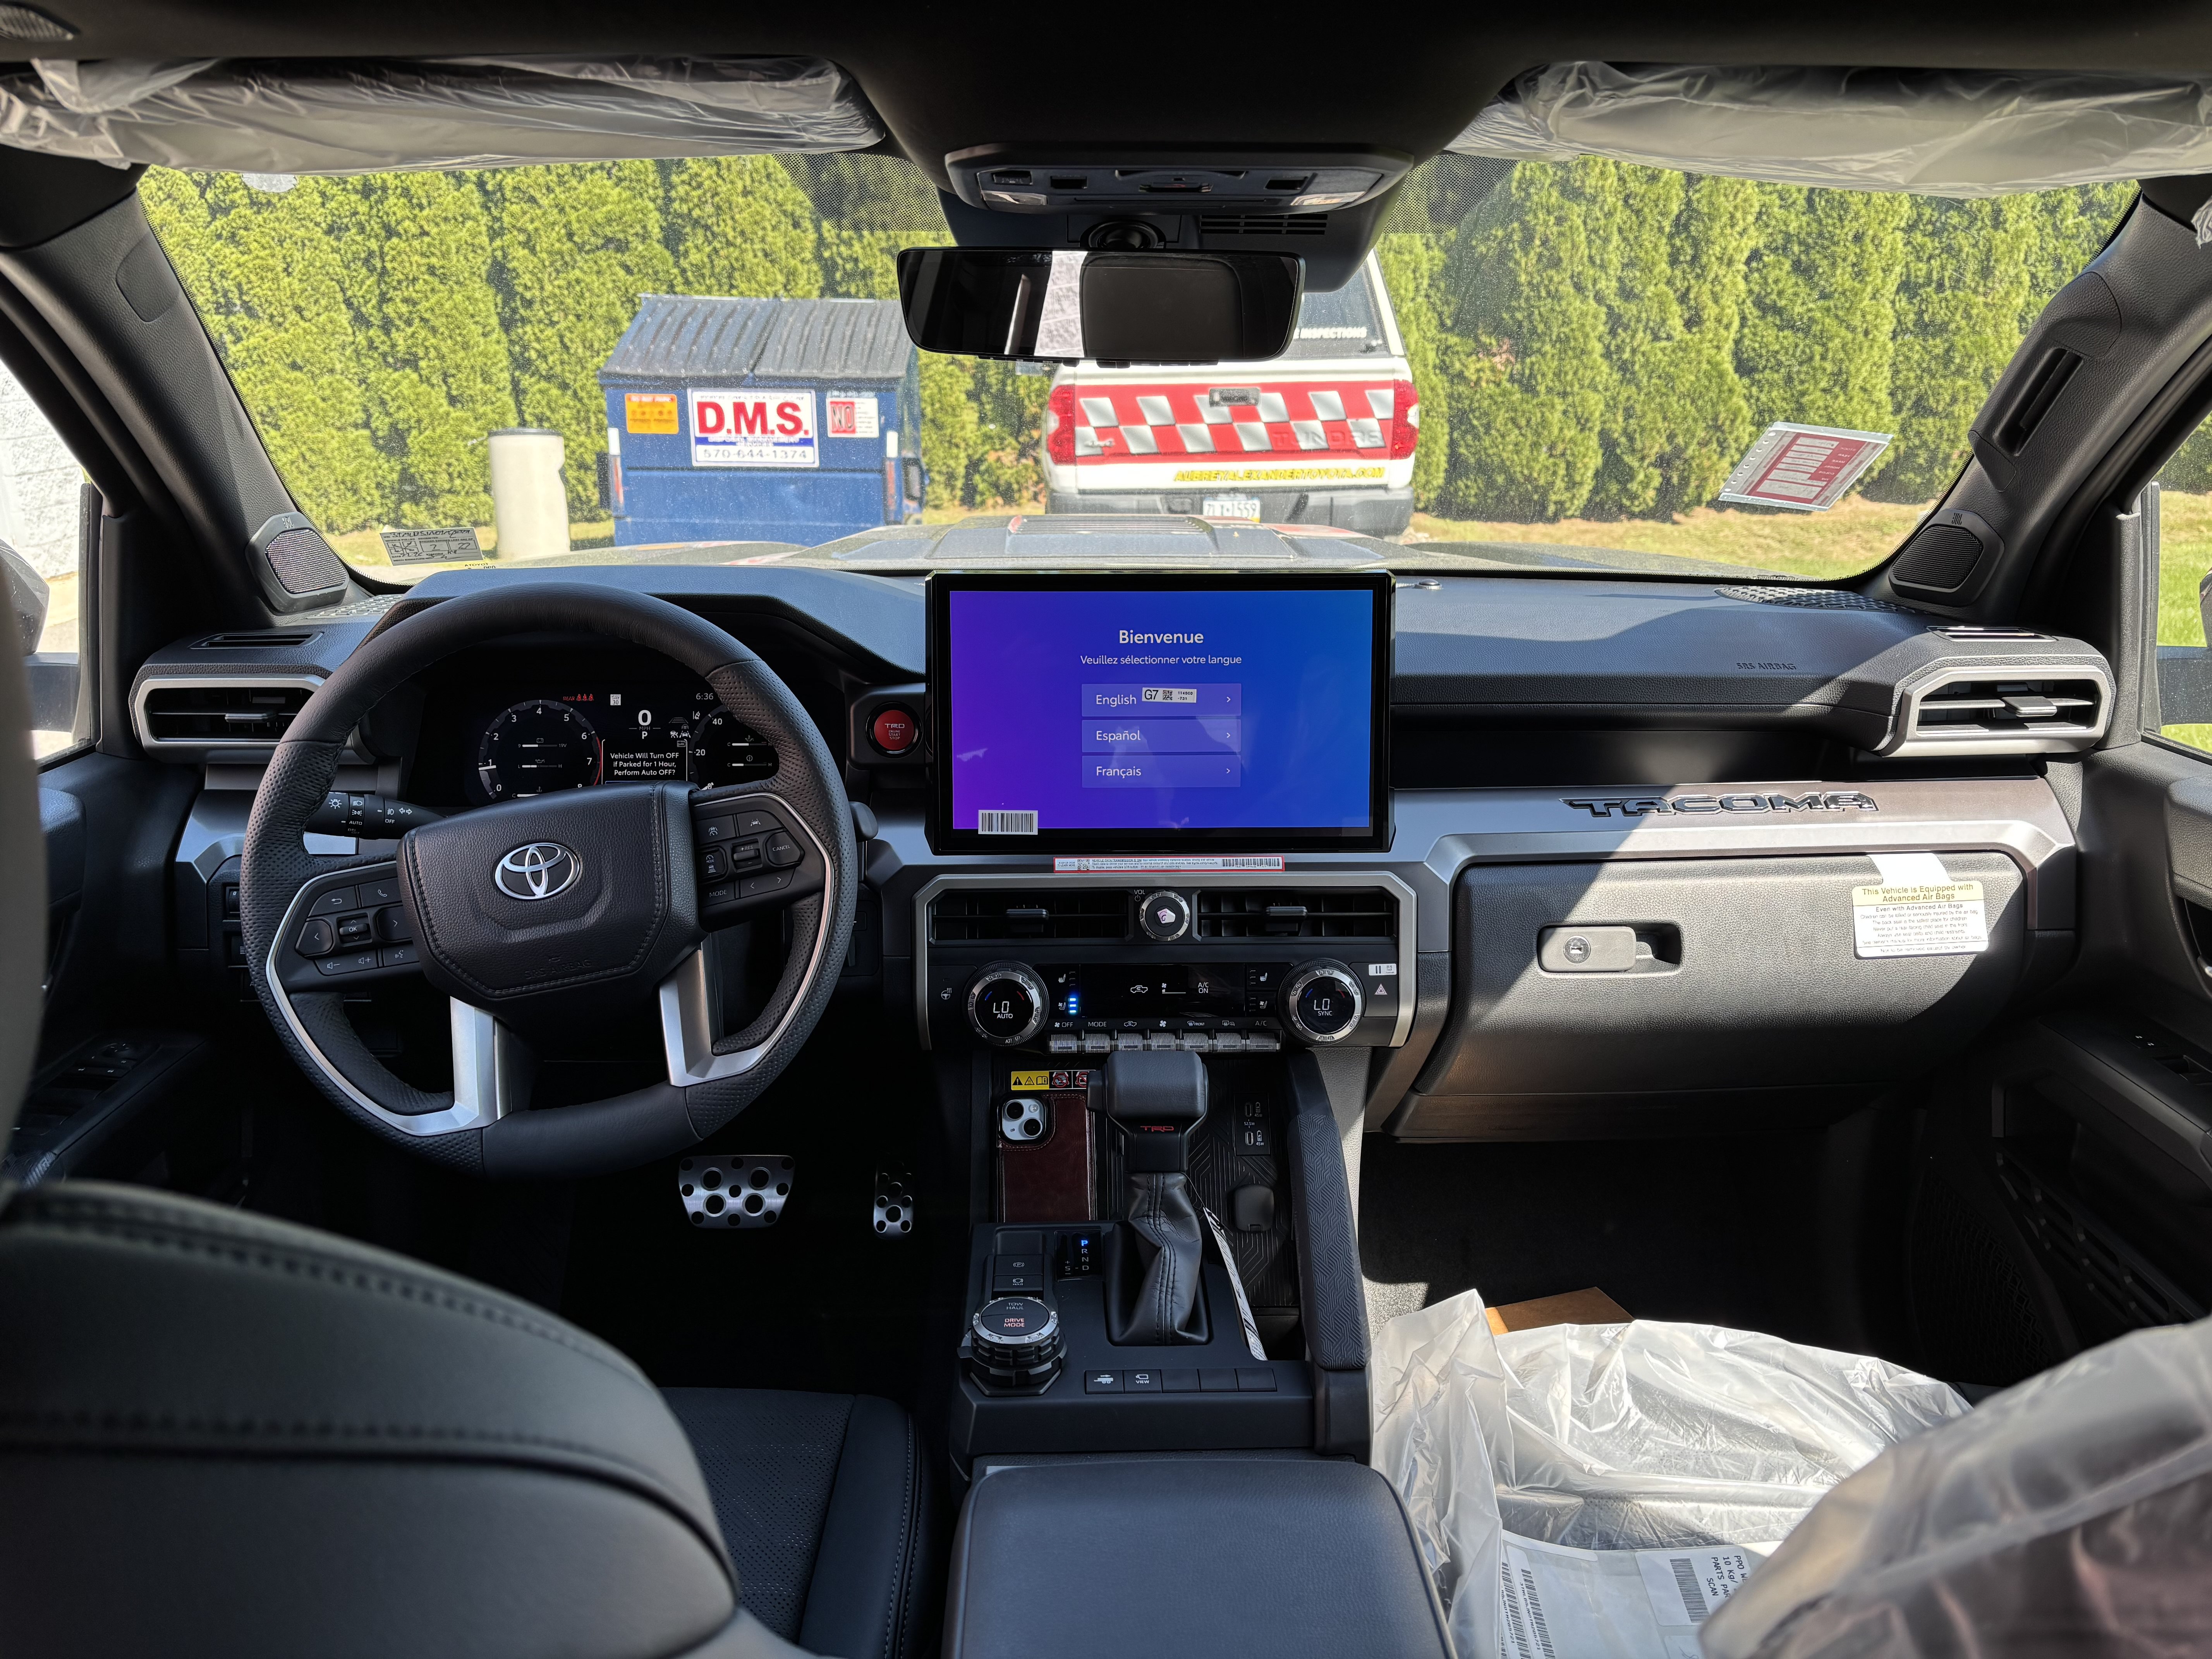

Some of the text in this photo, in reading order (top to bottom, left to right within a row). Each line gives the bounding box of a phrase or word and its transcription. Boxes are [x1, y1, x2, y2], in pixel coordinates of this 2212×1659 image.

[697, 401, 809, 436] D.M.S.
[831, 405, 854, 429] NO
[1272, 429, 1384, 448] TUNDRA
[1174, 467, 1384, 481] AUBREYALEXANDERTOYOTA.COM
[1119, 630, 1204, 644] Bienvenue
[1080, 655, 1118, 664] Veuillez
[1120, 655, 1180, 664] sélectionner
[1209, 655, 1242, 665] langue
[1144, 689, 1159, 700] G7
[1096, 695, 1137, 707] English
[638, 710, 651, 726] 0
[642, 731, 647, 739] P
[1097, 730, 1140, 742] Español
[1097, 766, 1142, 778] Français
[1559, 792, 1879, 817] TACOMA
[1920, 884, 1955, 894] Equipped
[1883, 894, 1920, 902] Advanced
[1936, 893, 1955, 901] Bags
[993, 1001, 1009, 1013] LO
[1314, 998, 1330, 1010] LO
[1723, 1556, 1731, 1565] 10
[1734, 1555, 1744, 1569] PPO
[1711, 1557, 1724, 1580] PARTS
[1707, 1578, 1719, 1596] SCAN
